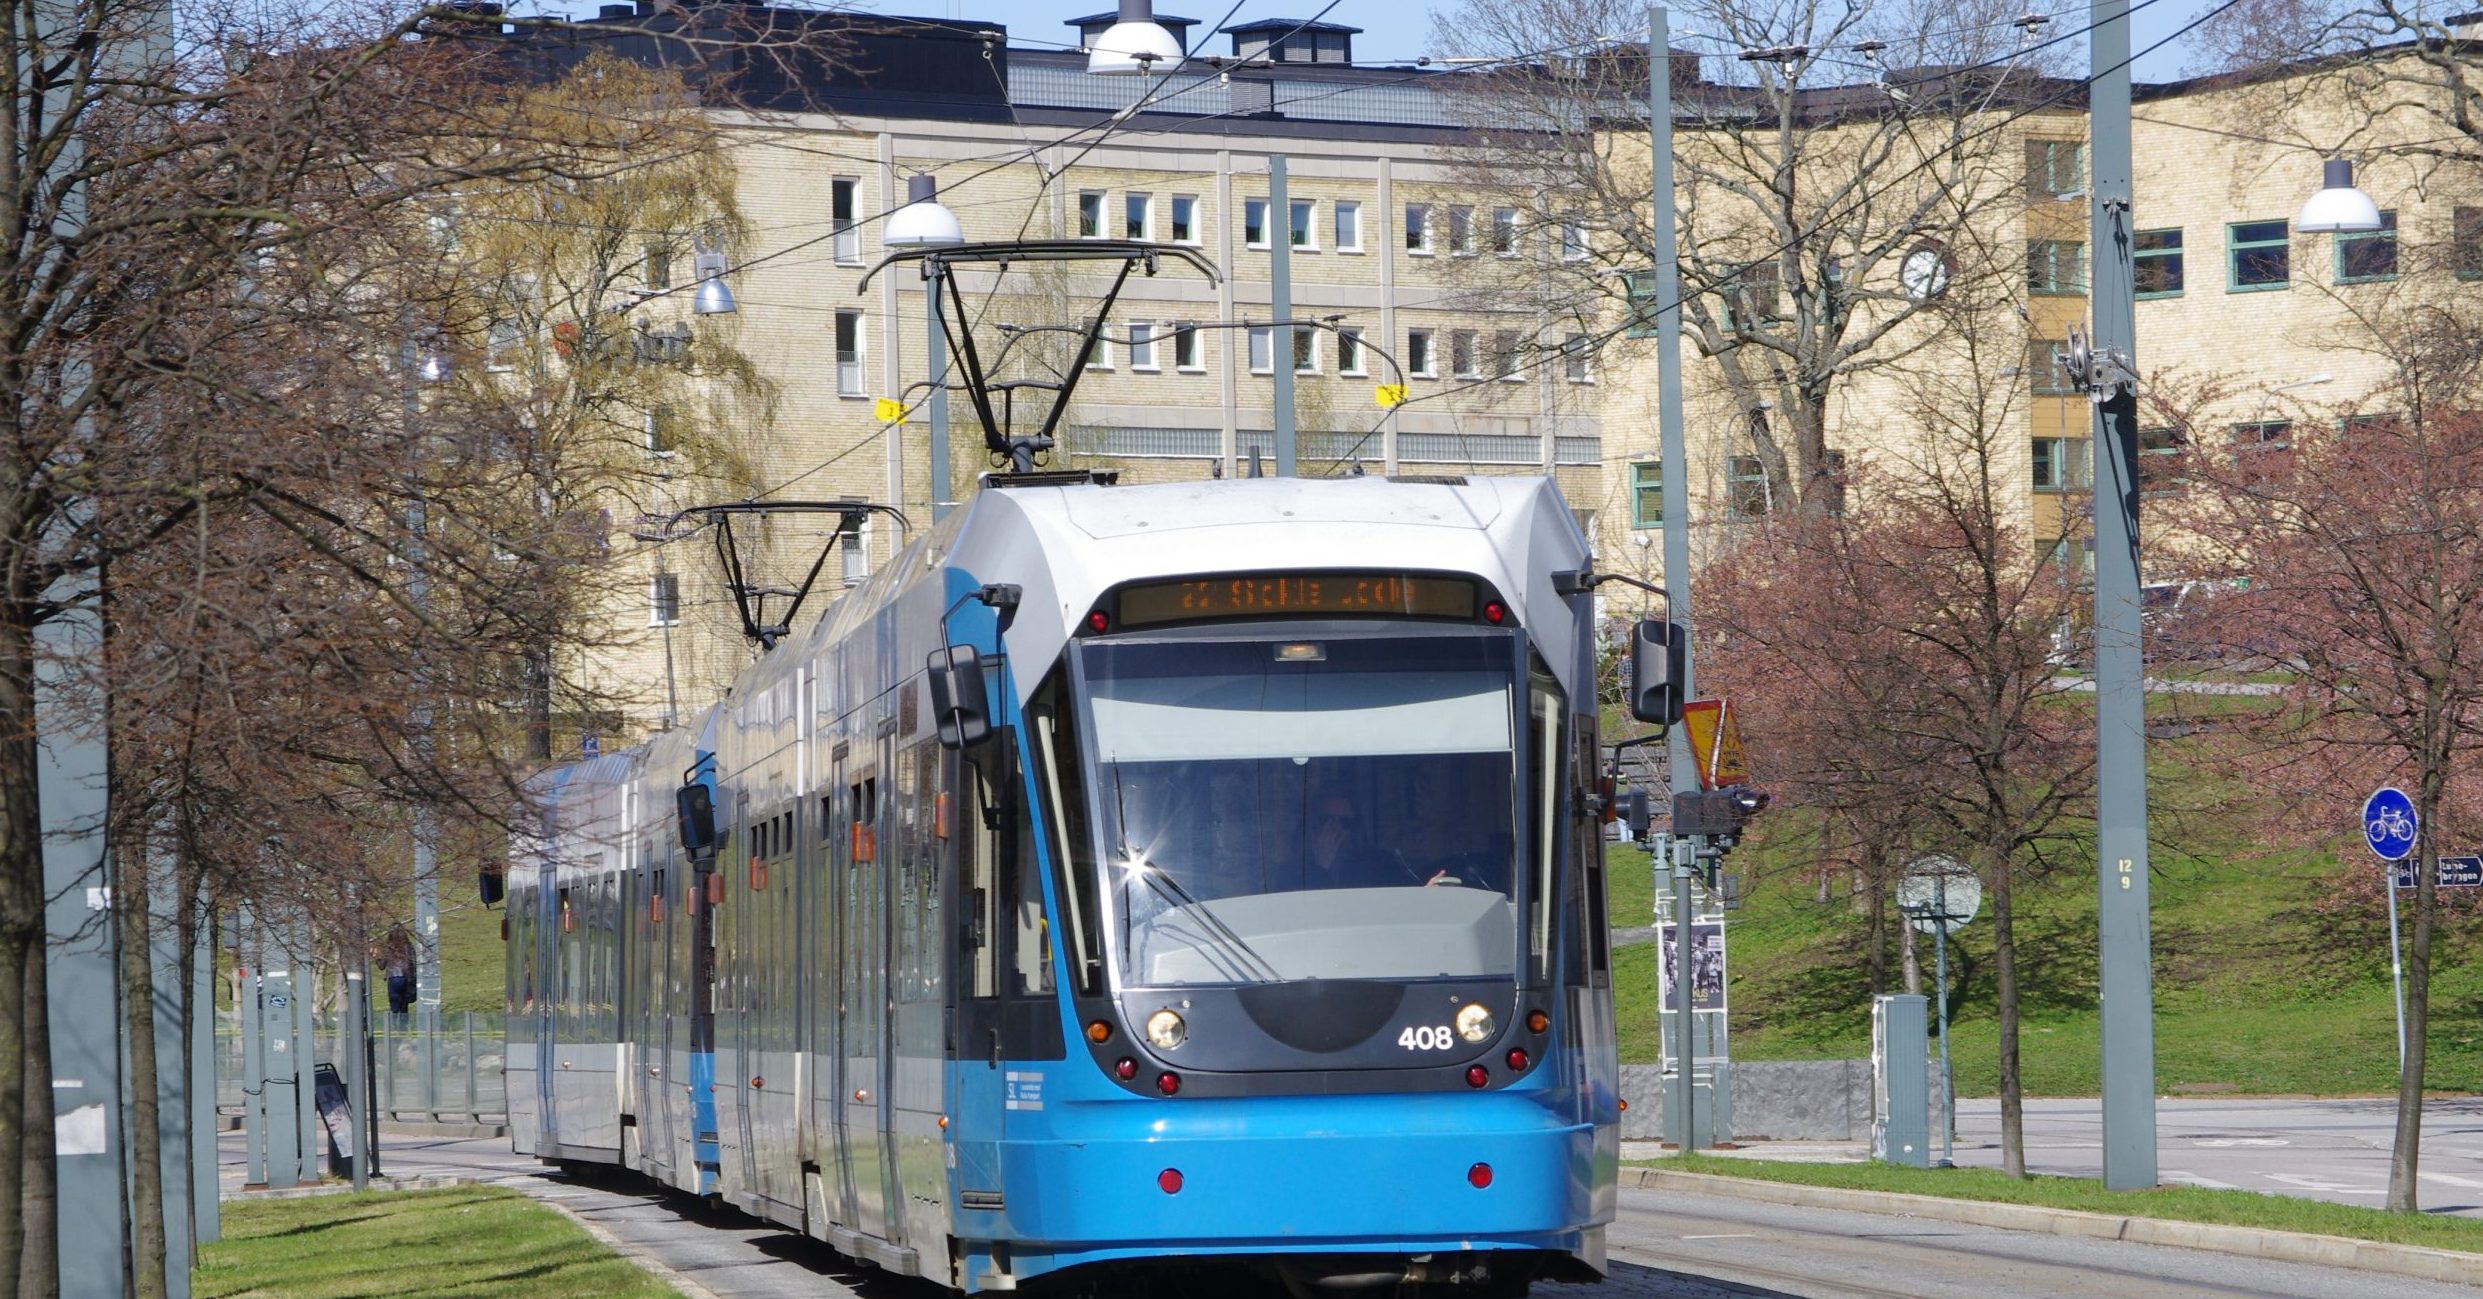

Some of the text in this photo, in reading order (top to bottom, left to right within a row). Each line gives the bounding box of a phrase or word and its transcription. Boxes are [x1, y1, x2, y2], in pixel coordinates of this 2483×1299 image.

[2118, 858, 2133, 873] 12
[2121, 875, 2131, 890] 9
[1397, 1025, 1454, 1051] 408
